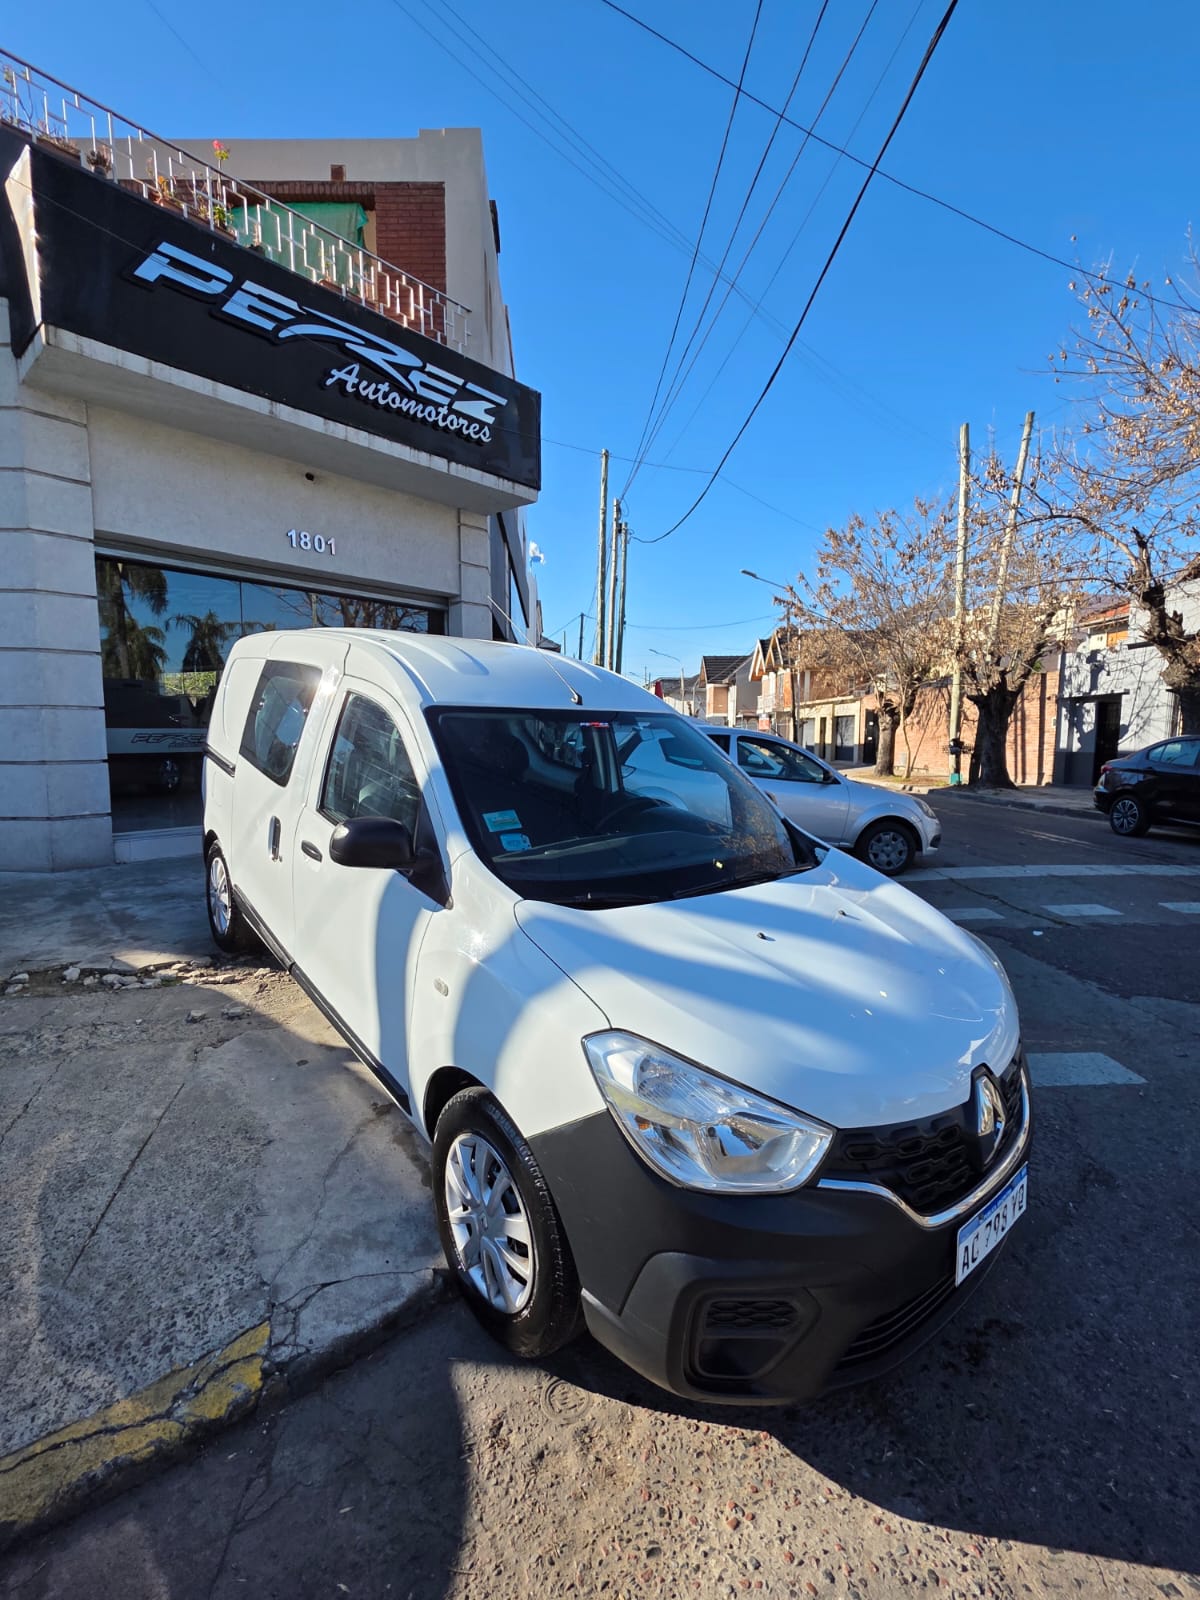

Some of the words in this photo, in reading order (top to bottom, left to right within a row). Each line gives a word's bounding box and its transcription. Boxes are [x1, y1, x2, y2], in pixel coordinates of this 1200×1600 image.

[134, 241, 508, 424] PEREZ
[330, 362, 492, 443] Automotores
[287, 529, 336, 556] 1801
[962, 1231, 980, 1274] AC
